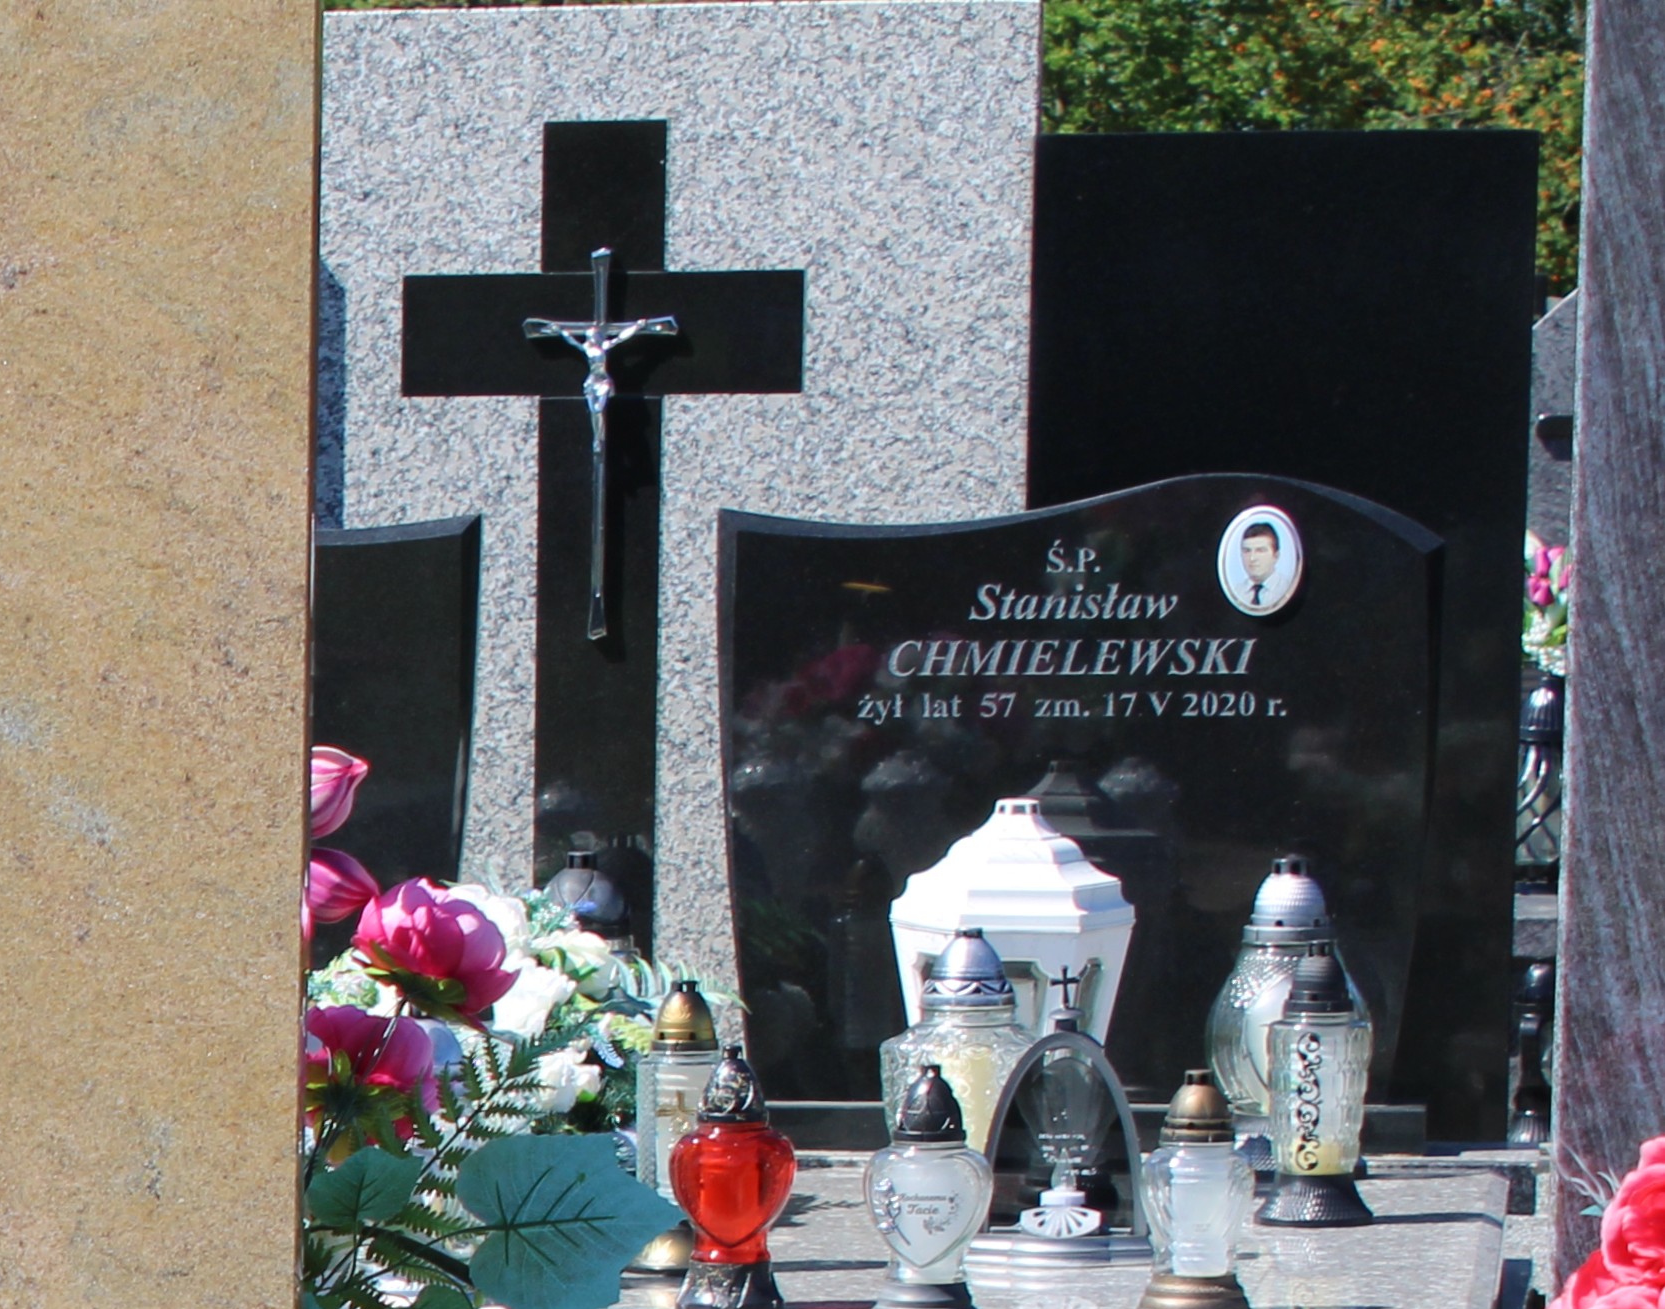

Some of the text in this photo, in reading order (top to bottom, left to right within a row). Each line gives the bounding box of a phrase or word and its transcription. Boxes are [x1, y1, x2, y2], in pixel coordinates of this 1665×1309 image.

[1045, 539, 1101, 574] Ś.P.
[968, 582, 1178, 622] Stanisław
[887, 637, 1257, 678] CHMIELEWSKI
[857, 691, 904, 726] żył
[922, 692, 962, 718] lat
[979, 692, 1017, 718] 57
[1034, 698, 1090, 718] zm.
[1181, 691, 1255, 717] 2020
[1265, 697, 1288, 718] r.
